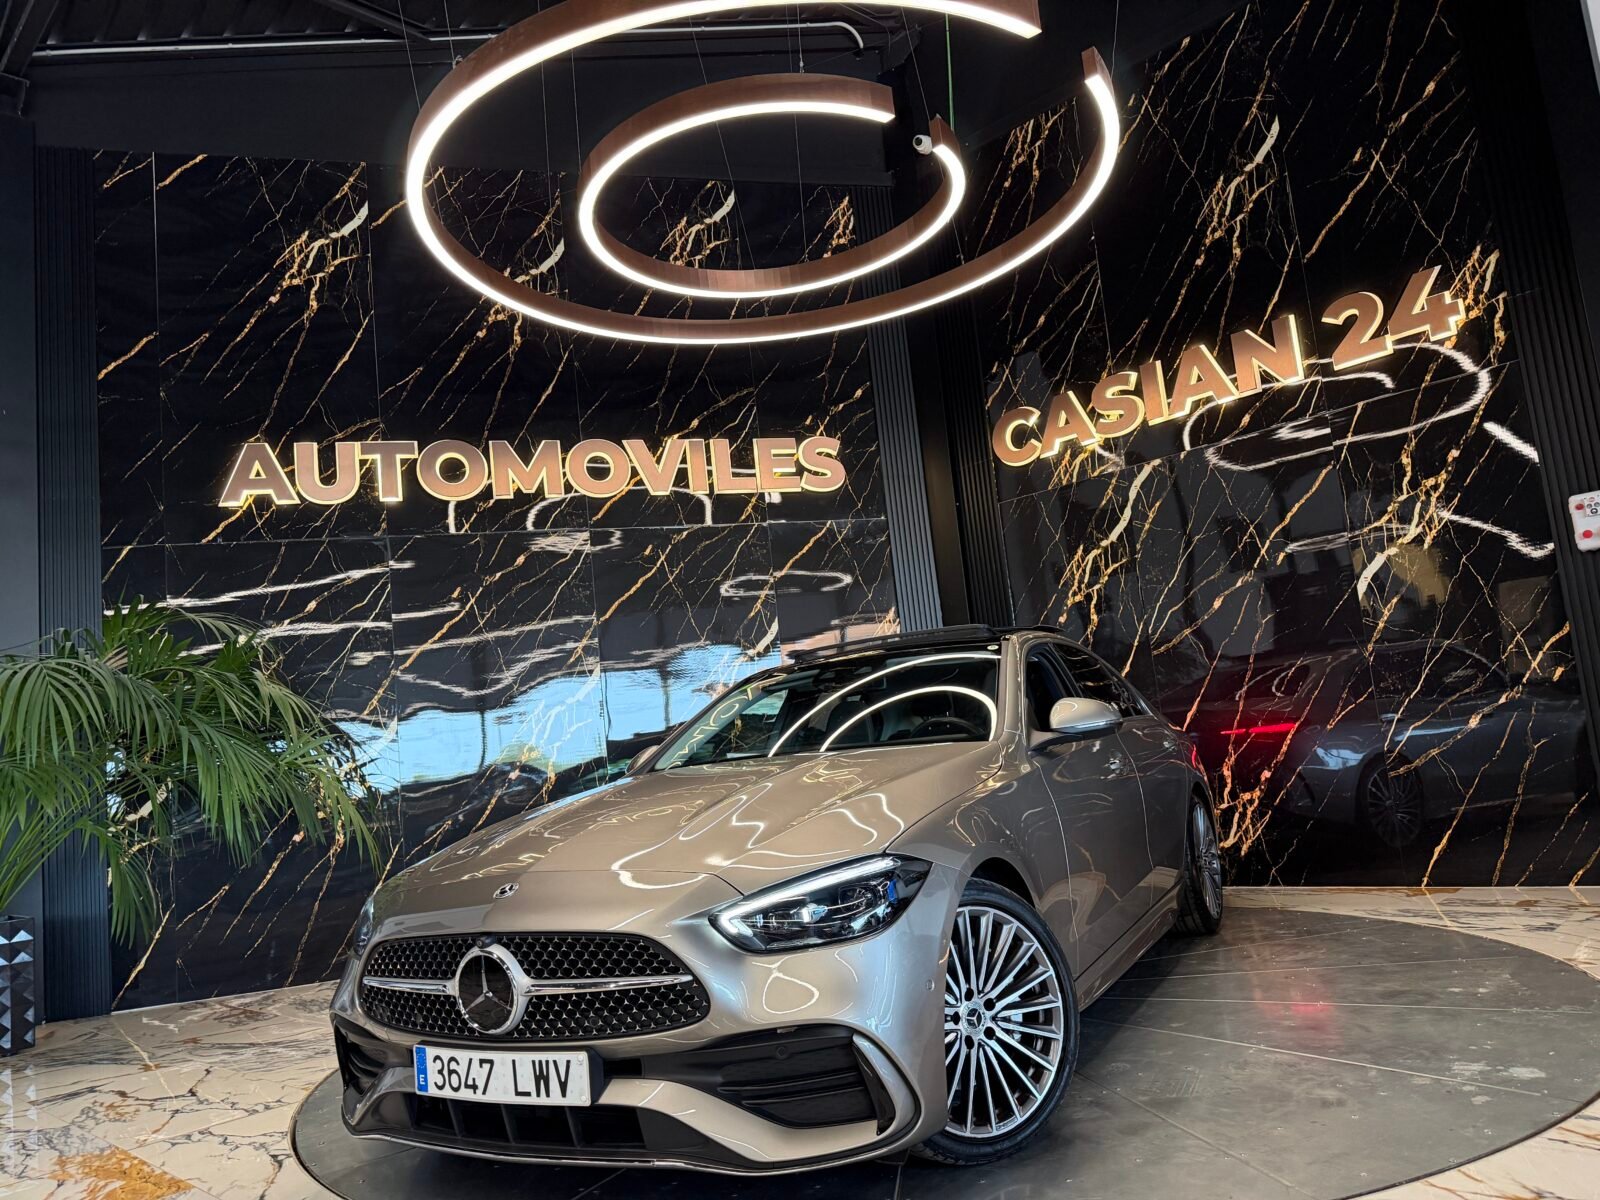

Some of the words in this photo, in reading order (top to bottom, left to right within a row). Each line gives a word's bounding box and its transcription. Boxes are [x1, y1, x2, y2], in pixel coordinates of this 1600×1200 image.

[992, 313, 1305, 467] CASIAN
[1321, 265, 1467, 371] 24
[219, 438, 847, 507] AUTOMOVILES
[419, 1074, 426, 1085] E
[432, 1054, 495, 1096] 3647
[511, 1058, 571, 1098] LWV
